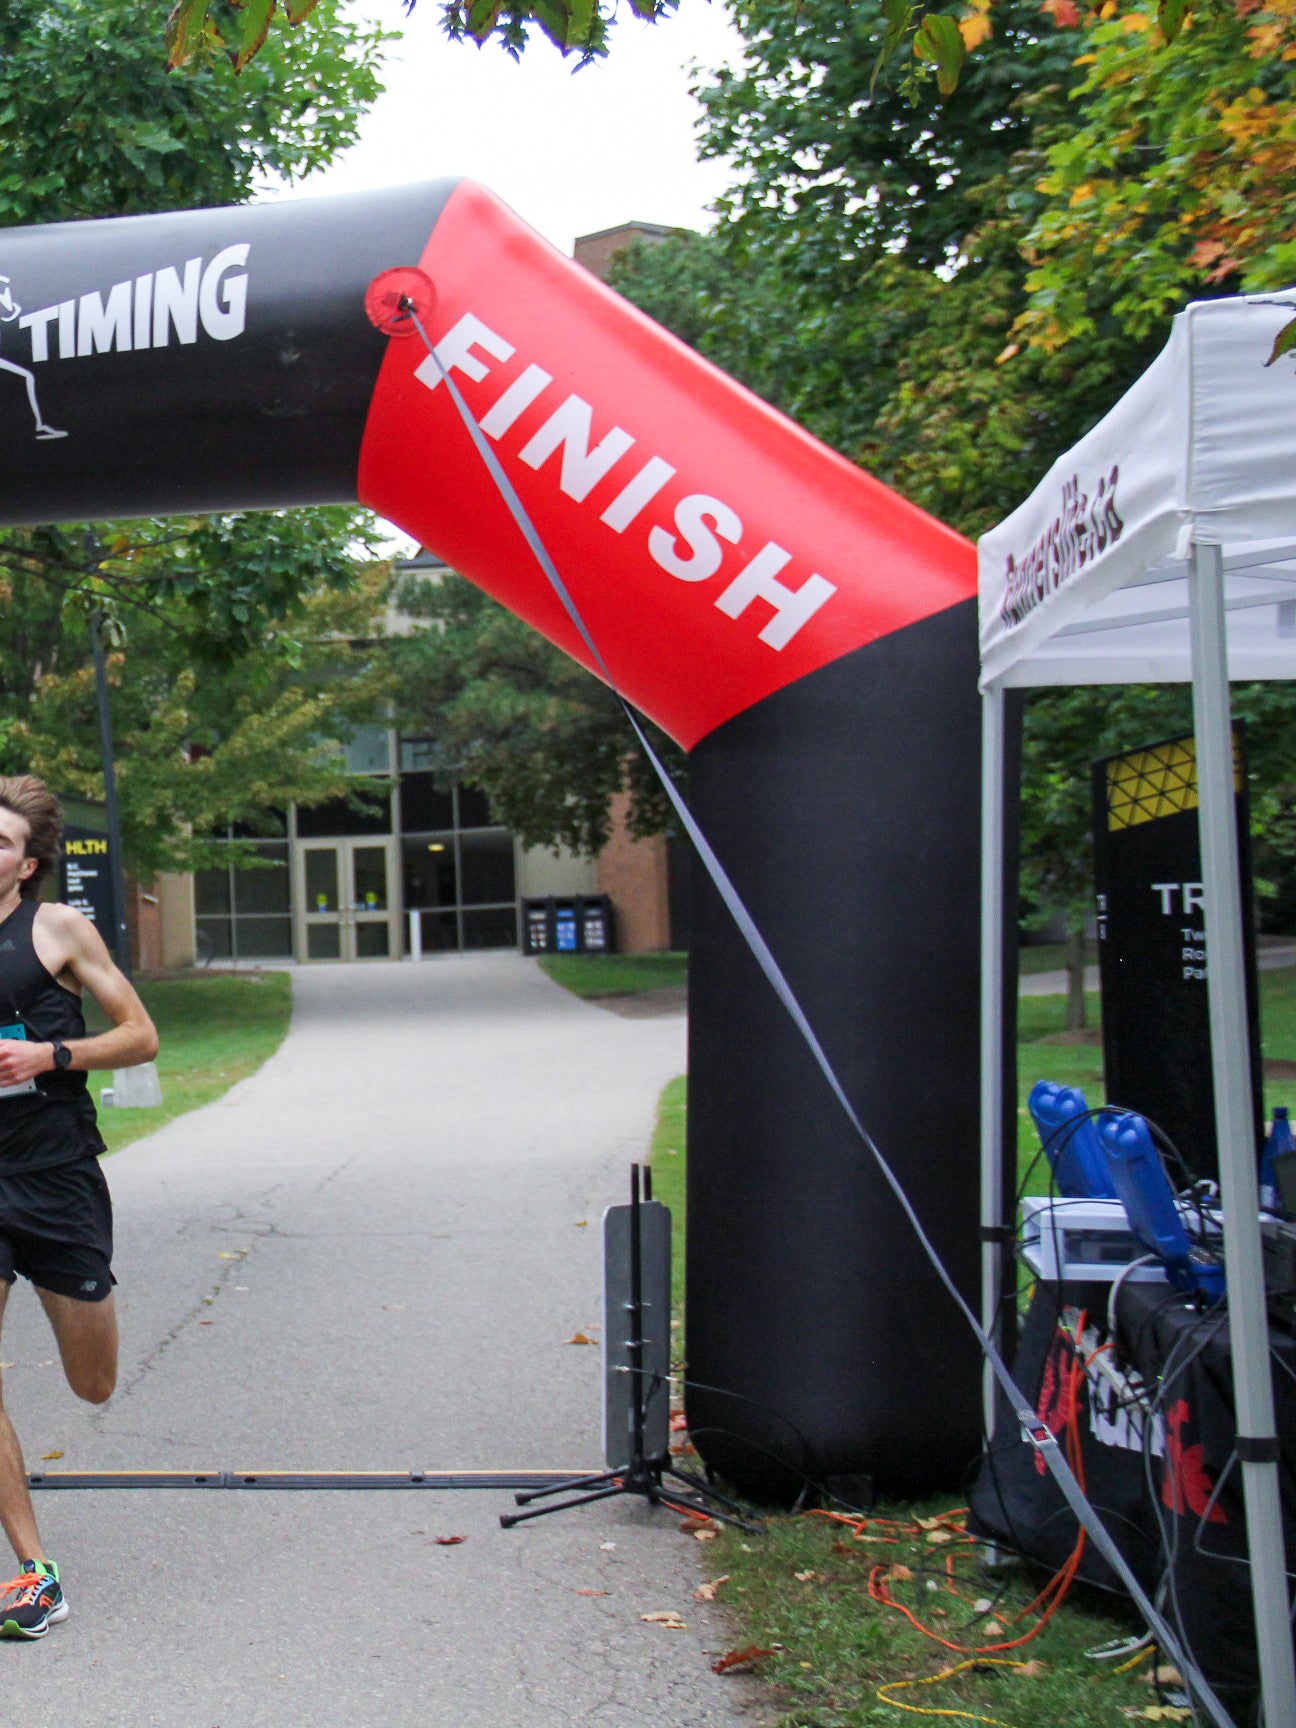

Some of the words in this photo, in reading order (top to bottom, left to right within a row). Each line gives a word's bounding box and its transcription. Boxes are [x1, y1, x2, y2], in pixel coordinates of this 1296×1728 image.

[18, 242, 252, 363] TIMING
[413, 312, 839, 652] FINISH
[65, 838, 108, 855] HLTH
[1183, 966, 1208, 980] Pa
